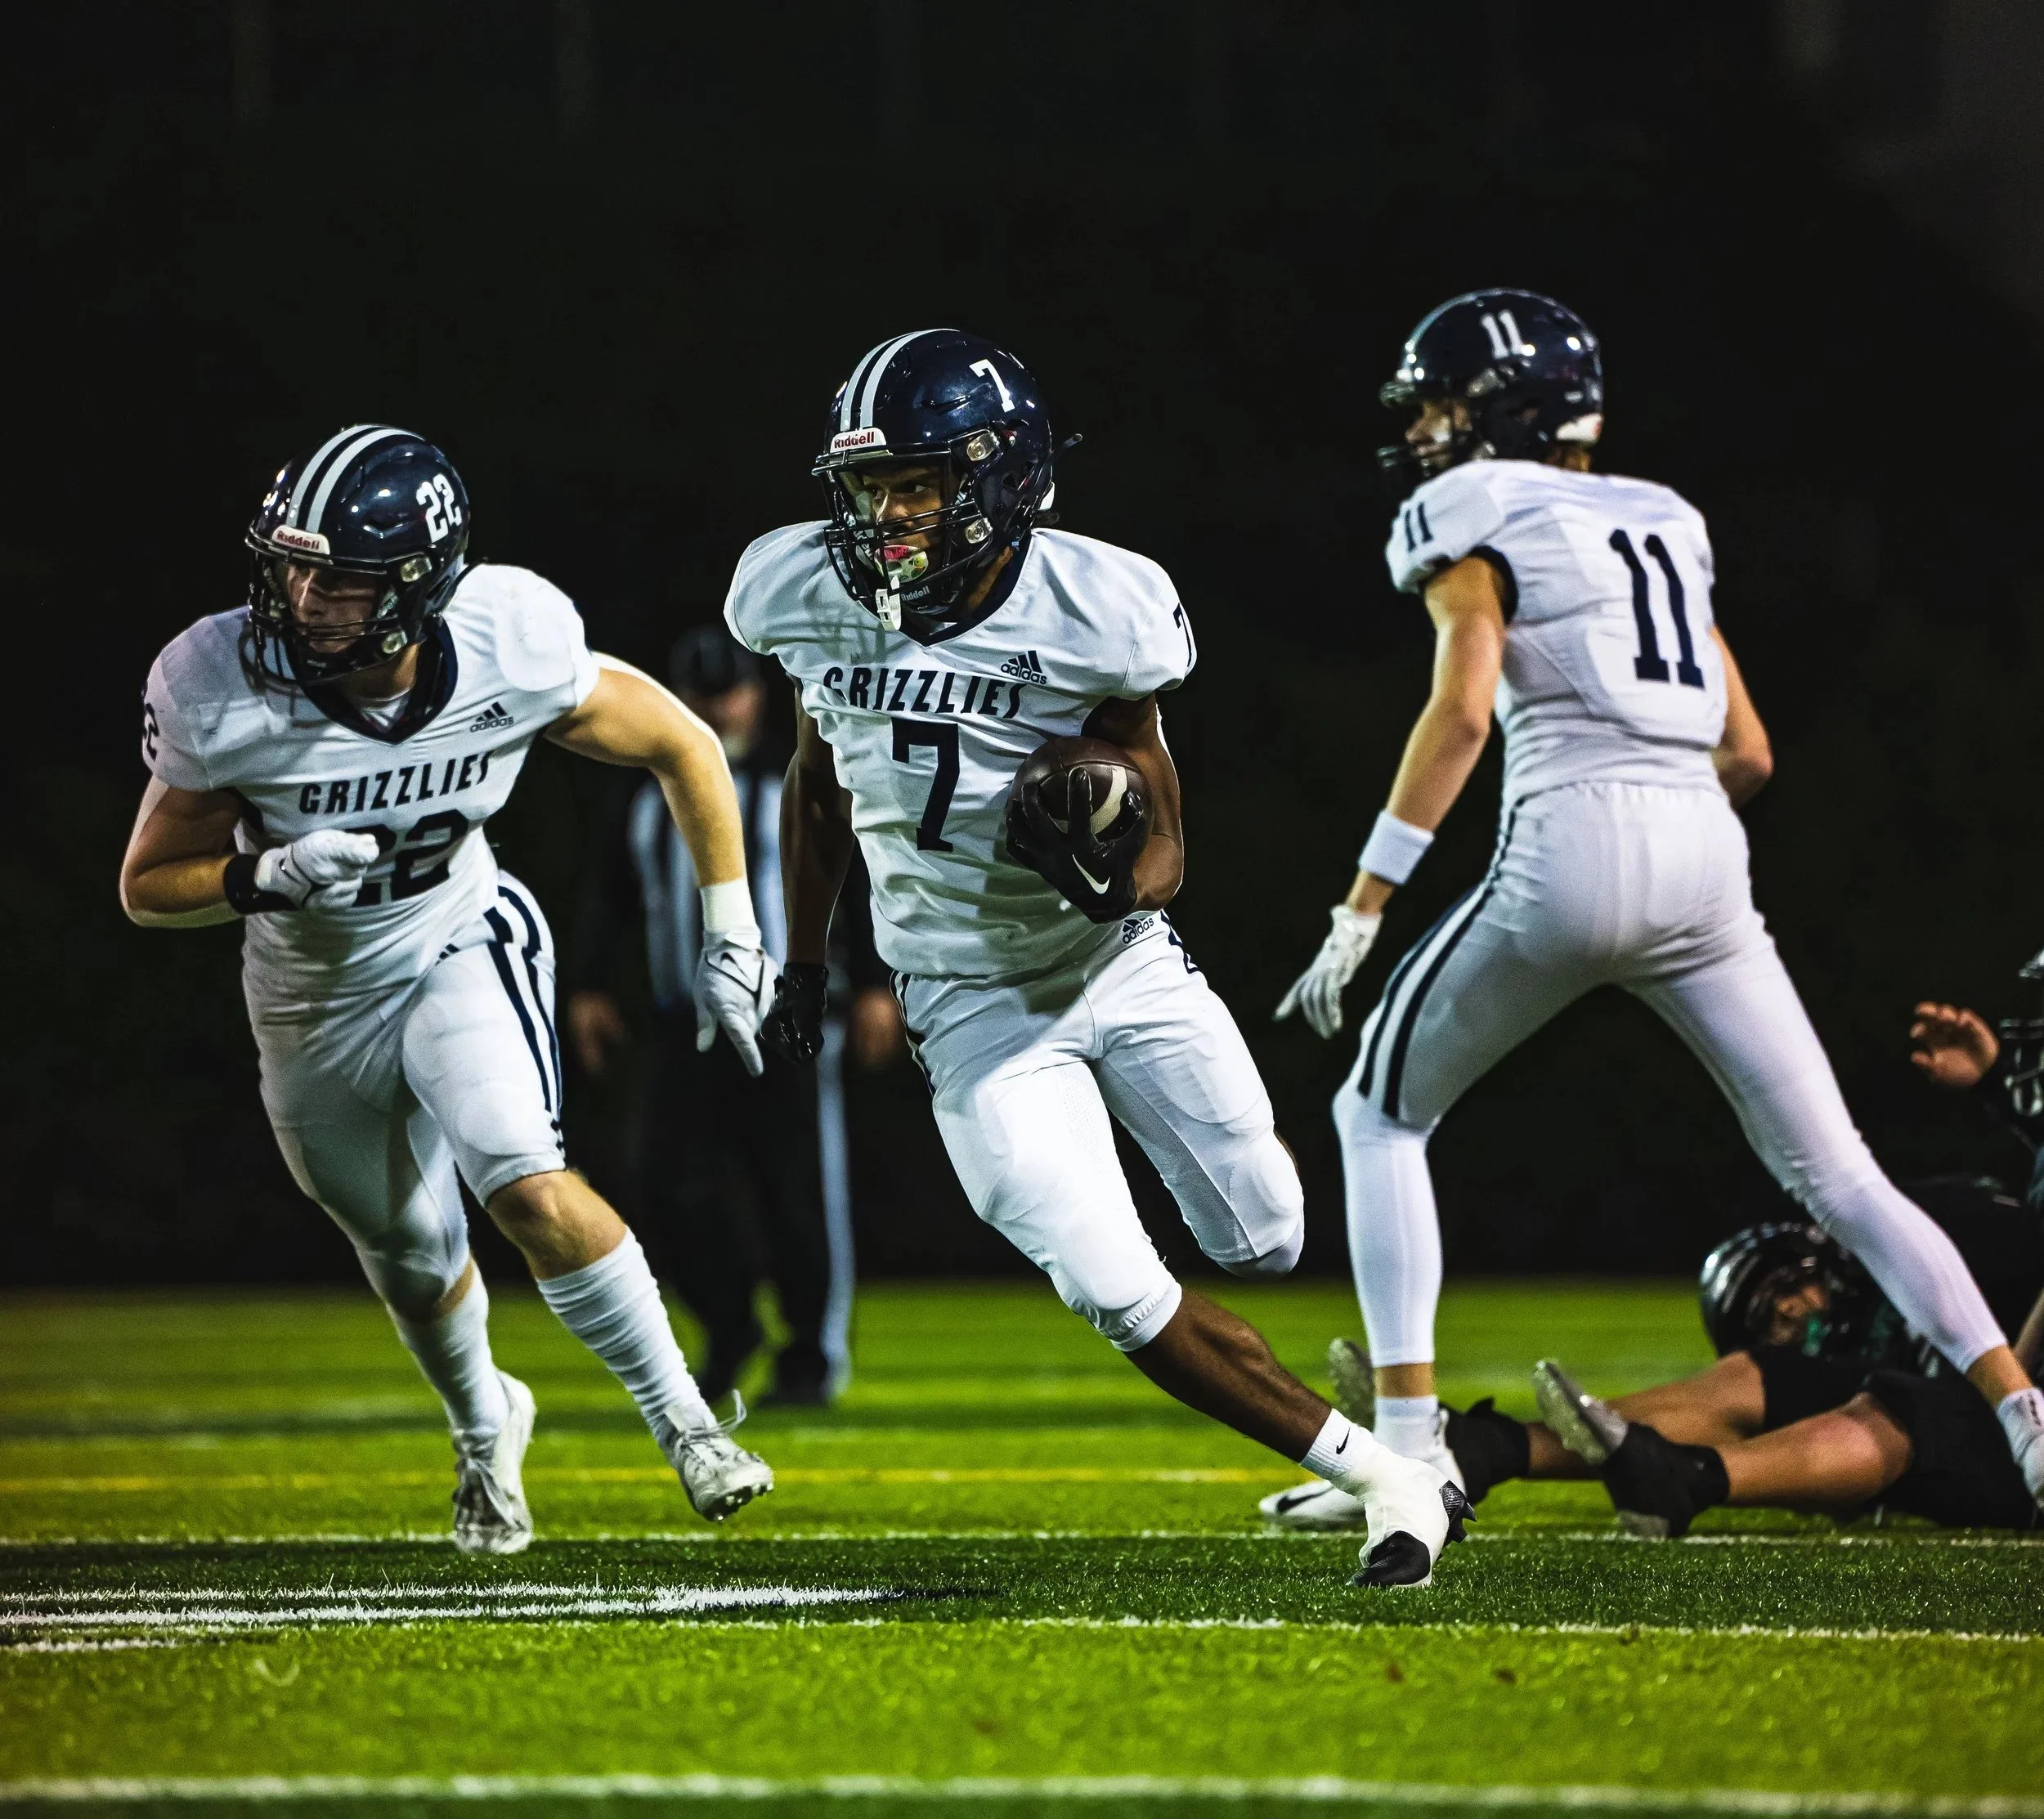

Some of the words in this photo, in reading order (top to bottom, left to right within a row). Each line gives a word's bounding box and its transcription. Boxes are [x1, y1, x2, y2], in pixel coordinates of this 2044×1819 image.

[1481, 309, 1525, 358] 11
[969, 359, 1015, 413] 7
[834, 431, 875, 449] Riddell
[415, 473, 463, 544] 22
[1404, 501, 1434, 553] 11
[276, 530, 320, 550] Riddell
[900, 585, 930, 602] Riddell
[1608, 528, 1706, 691] 11
[1000, 663, 1047, 685] adidas
[469, 715, 513, 733] adidas
[299, 750, 495, 815] GRIZZLIES
[891, 717, 961, 853] 7
[1122, 916, 1154, 944] adidas
